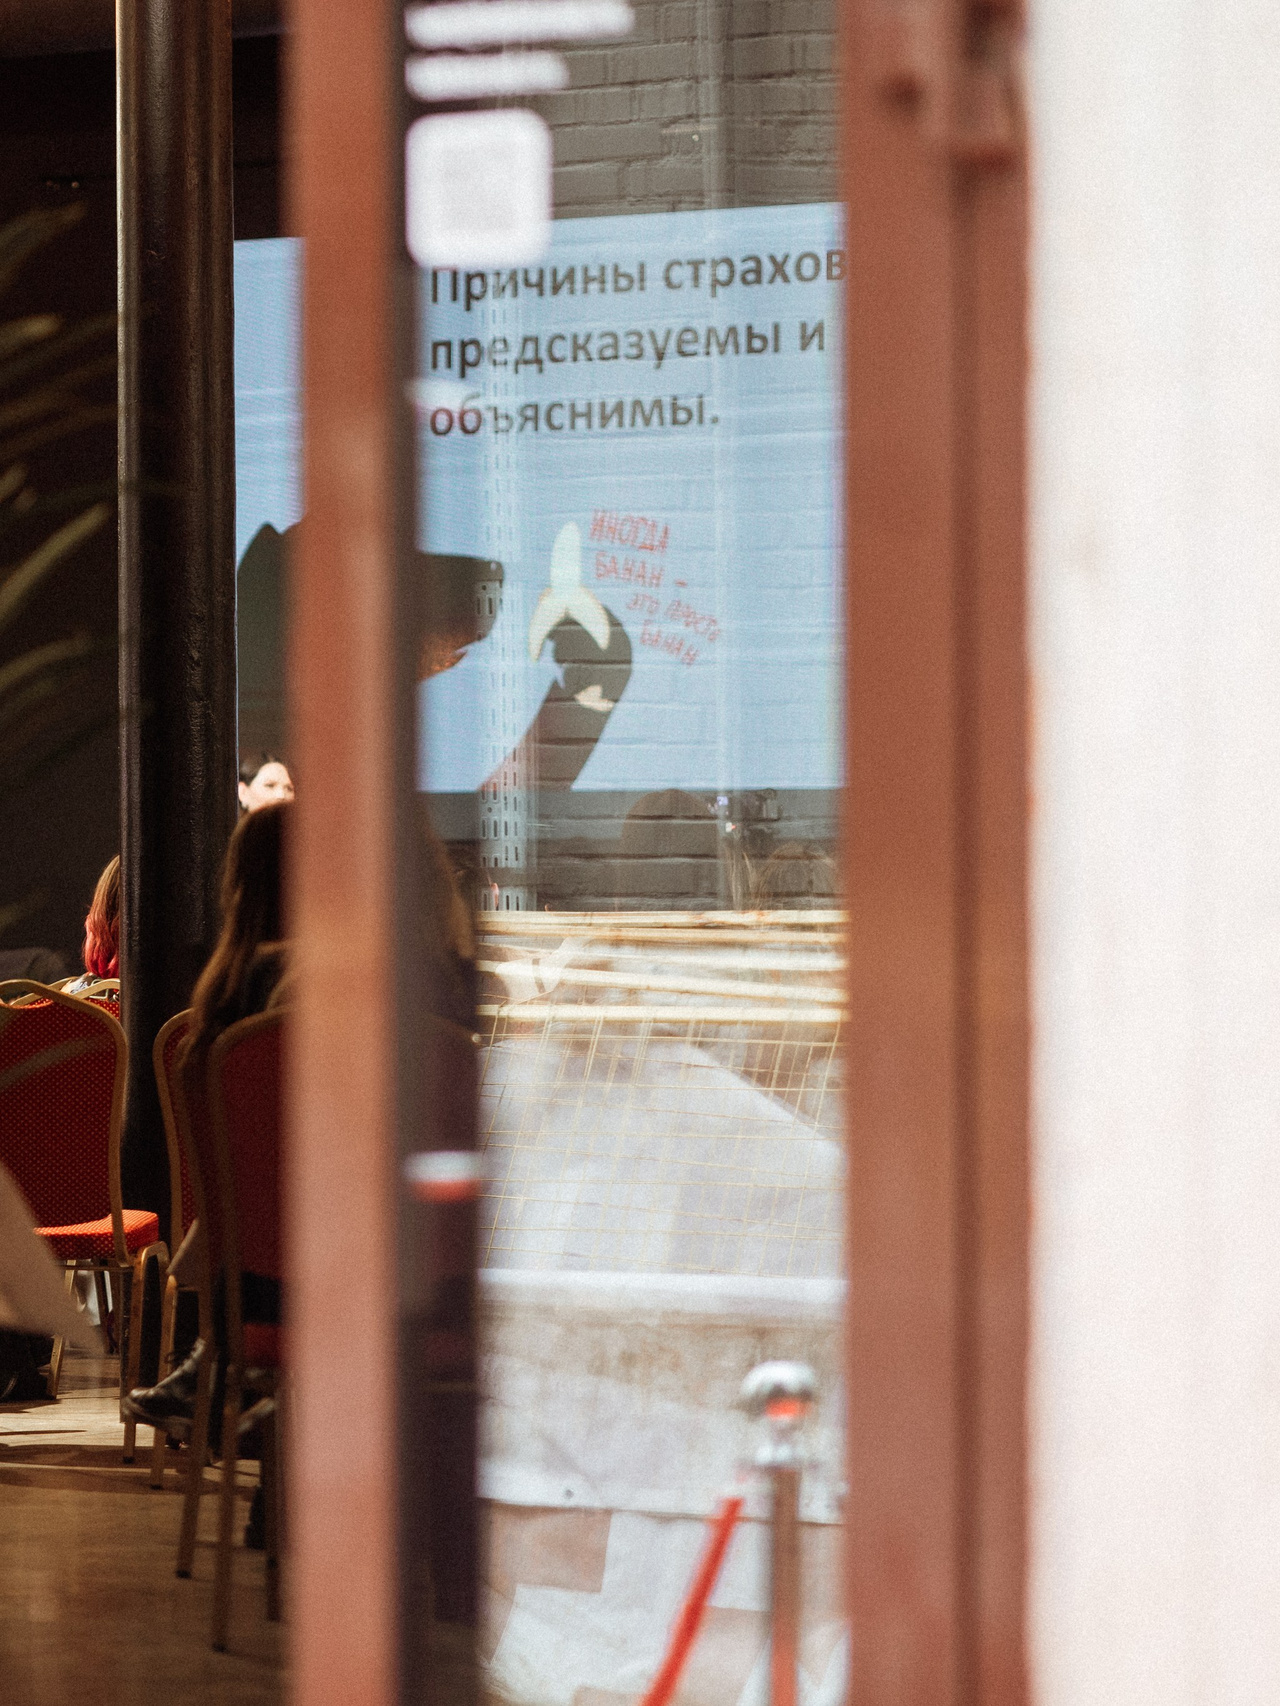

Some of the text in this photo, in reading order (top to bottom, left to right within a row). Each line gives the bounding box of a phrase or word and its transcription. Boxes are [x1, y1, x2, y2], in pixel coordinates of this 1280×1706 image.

[431, 249, 847, 311] Причины страхов
[431, 318, 826, 378] предсказуемы и
[430, 392, 719, 436] объяснимы.
[595, 551, 664, 588] БАНАН
